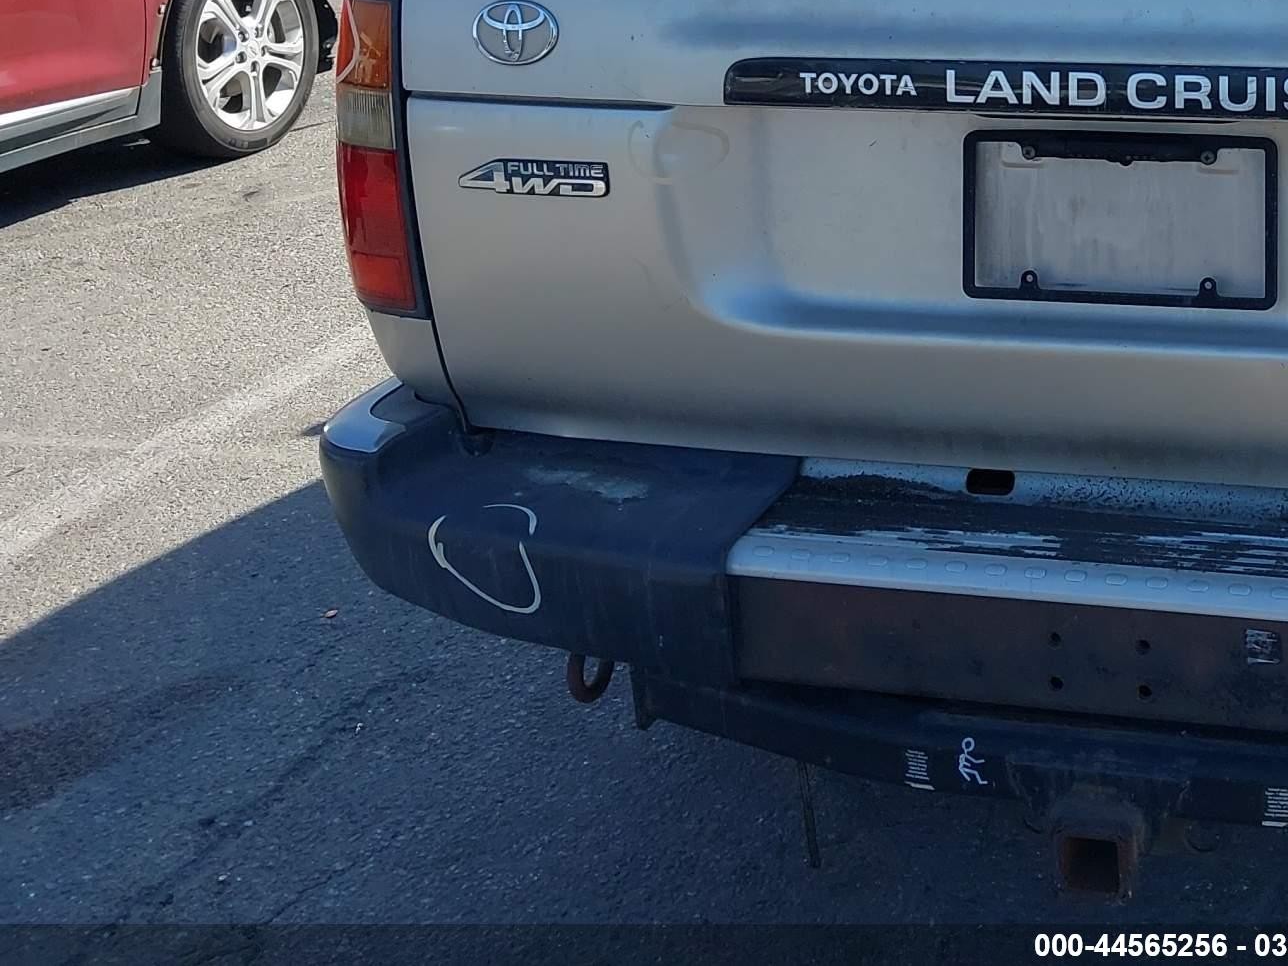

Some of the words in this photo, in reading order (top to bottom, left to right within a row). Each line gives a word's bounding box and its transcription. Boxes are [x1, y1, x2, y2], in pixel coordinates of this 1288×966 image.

[800, 72, 917, 96] TOYOTA
[945, 69, 1105, 107] LAND
[508, 162, 554, 176] FULL
[555, 164, 604, 177] TIME
